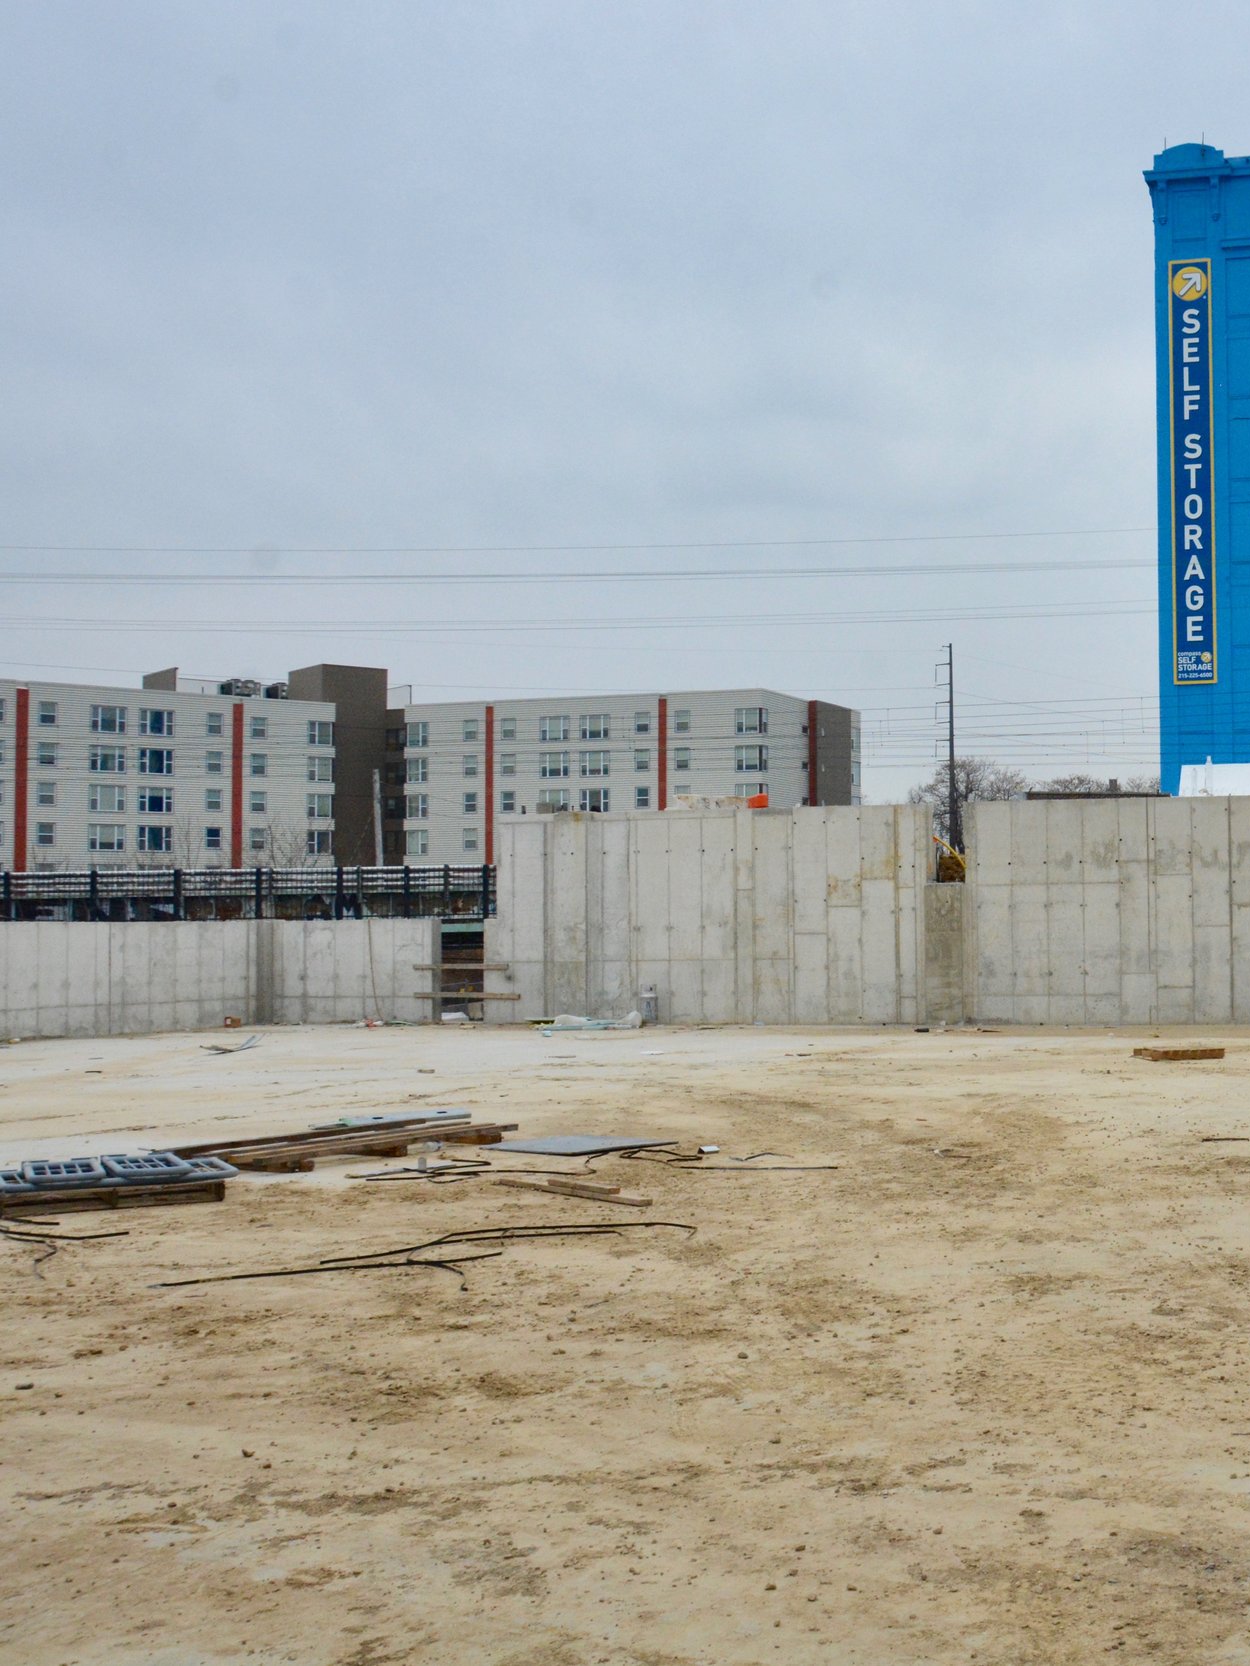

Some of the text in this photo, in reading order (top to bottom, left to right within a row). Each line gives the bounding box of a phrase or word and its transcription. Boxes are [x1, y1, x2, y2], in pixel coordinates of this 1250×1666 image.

[1181, 308, 1206, 642] SELF STORAGE
[1177, 656, 1196, 664] SELF
[1178, 663, 1213, 671] STORAGE
